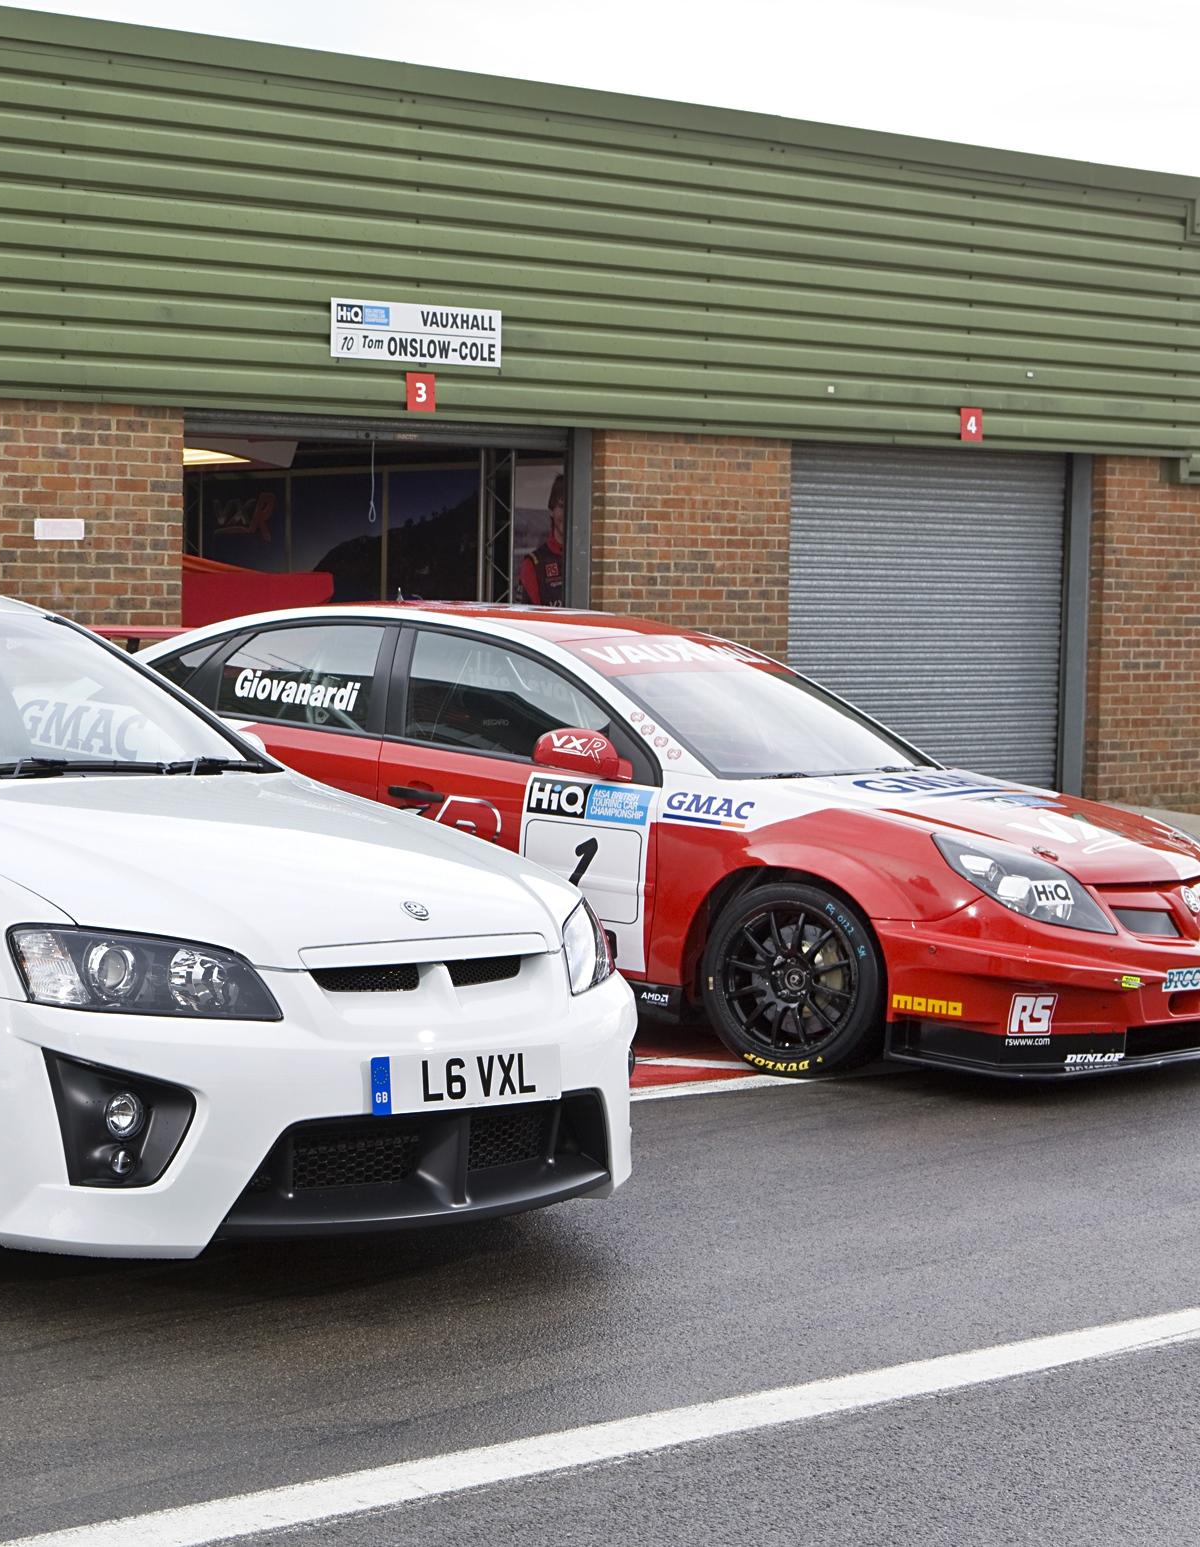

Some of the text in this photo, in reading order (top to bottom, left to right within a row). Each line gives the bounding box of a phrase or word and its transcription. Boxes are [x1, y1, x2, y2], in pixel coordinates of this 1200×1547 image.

[337, 305, 363, 322] HiQ
[420, 311, 496, 332] VAUXHALL
[341, 335, 496, 362] 10 Tom ONSLOW-COLE
[415, 382, 427, 403] 3
[966, 415, 977, 434] 4
[234, 668, 361, 712] Giovanardi
[18, 698, 148, 761] GMAC
[550, 732, 607, 767] VXR
[529, 782, 641, 815] HiQ MSA BRITISH
[592, 797, 639, 811] TOURING CAR
[666, 791, 755, 820] GMAC
[590, 805, 644, 820] CHAMPIONSHIP
[1034, 883, 1070, 902] HiQ
[640, 991, 662, 1002] AMD
[892, 993, 963, 1017] momo
[1009, 996, 1055, 1033] RS
[1004, 1037, 1050, 1047] rswww.com
[743, 1052, 810, 1073] DUNLOP
[1063, 1052, 1125, 1064] DUNLOP
[421, 1052, 537, 1102] L6 VXL
[375, 1091, 388, 1104] GB
